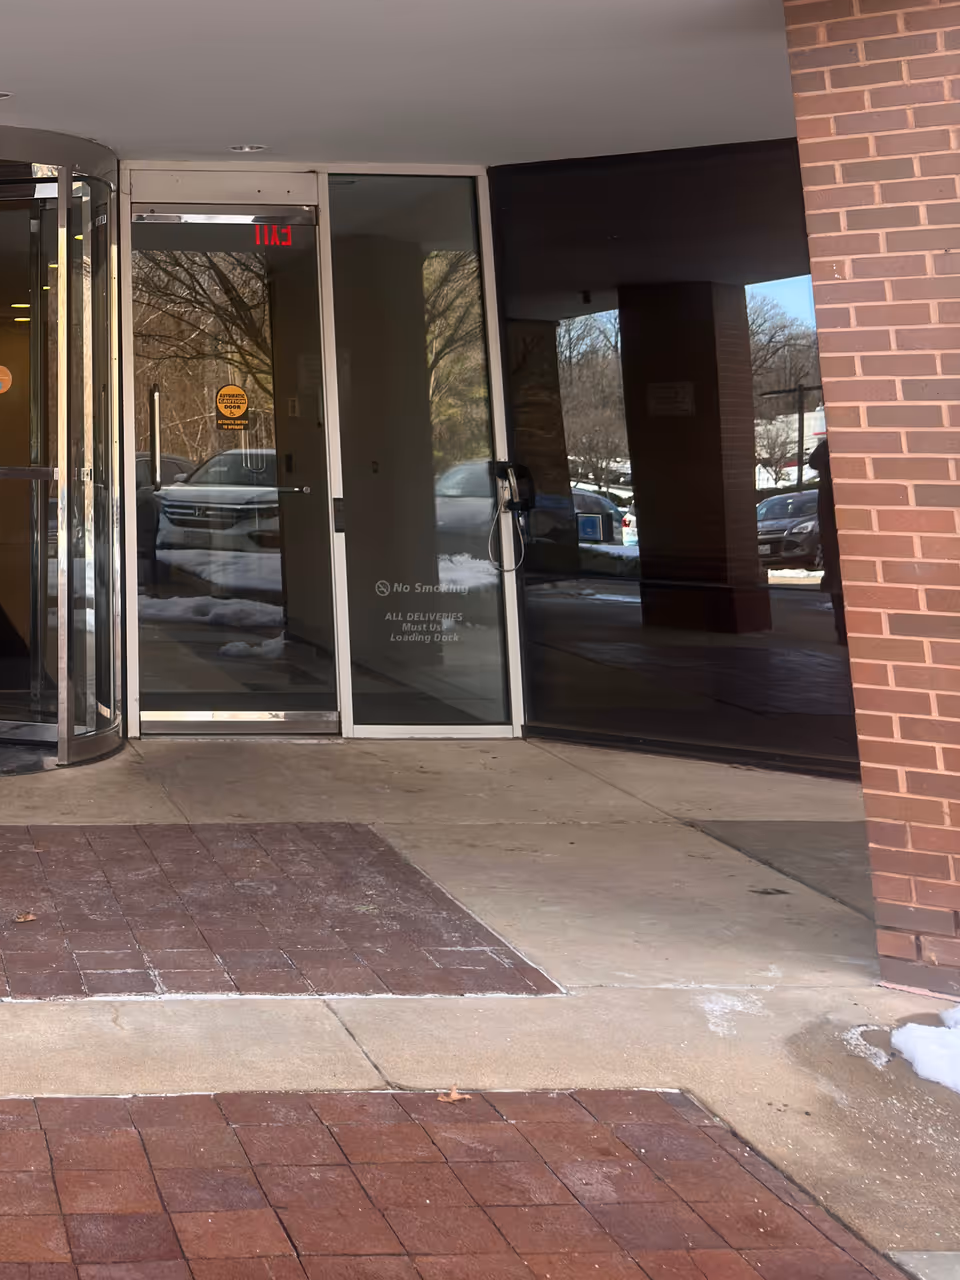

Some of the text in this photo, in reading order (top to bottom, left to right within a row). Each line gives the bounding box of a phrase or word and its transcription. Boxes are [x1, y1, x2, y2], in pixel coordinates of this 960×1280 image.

[393, 582, 469, 595] No Smoking
[384, 612, 464, 621] ALL DELIVERIES
[401, 622, 427, 632] Must
[390, 632, 459, 643] Loading Dock
